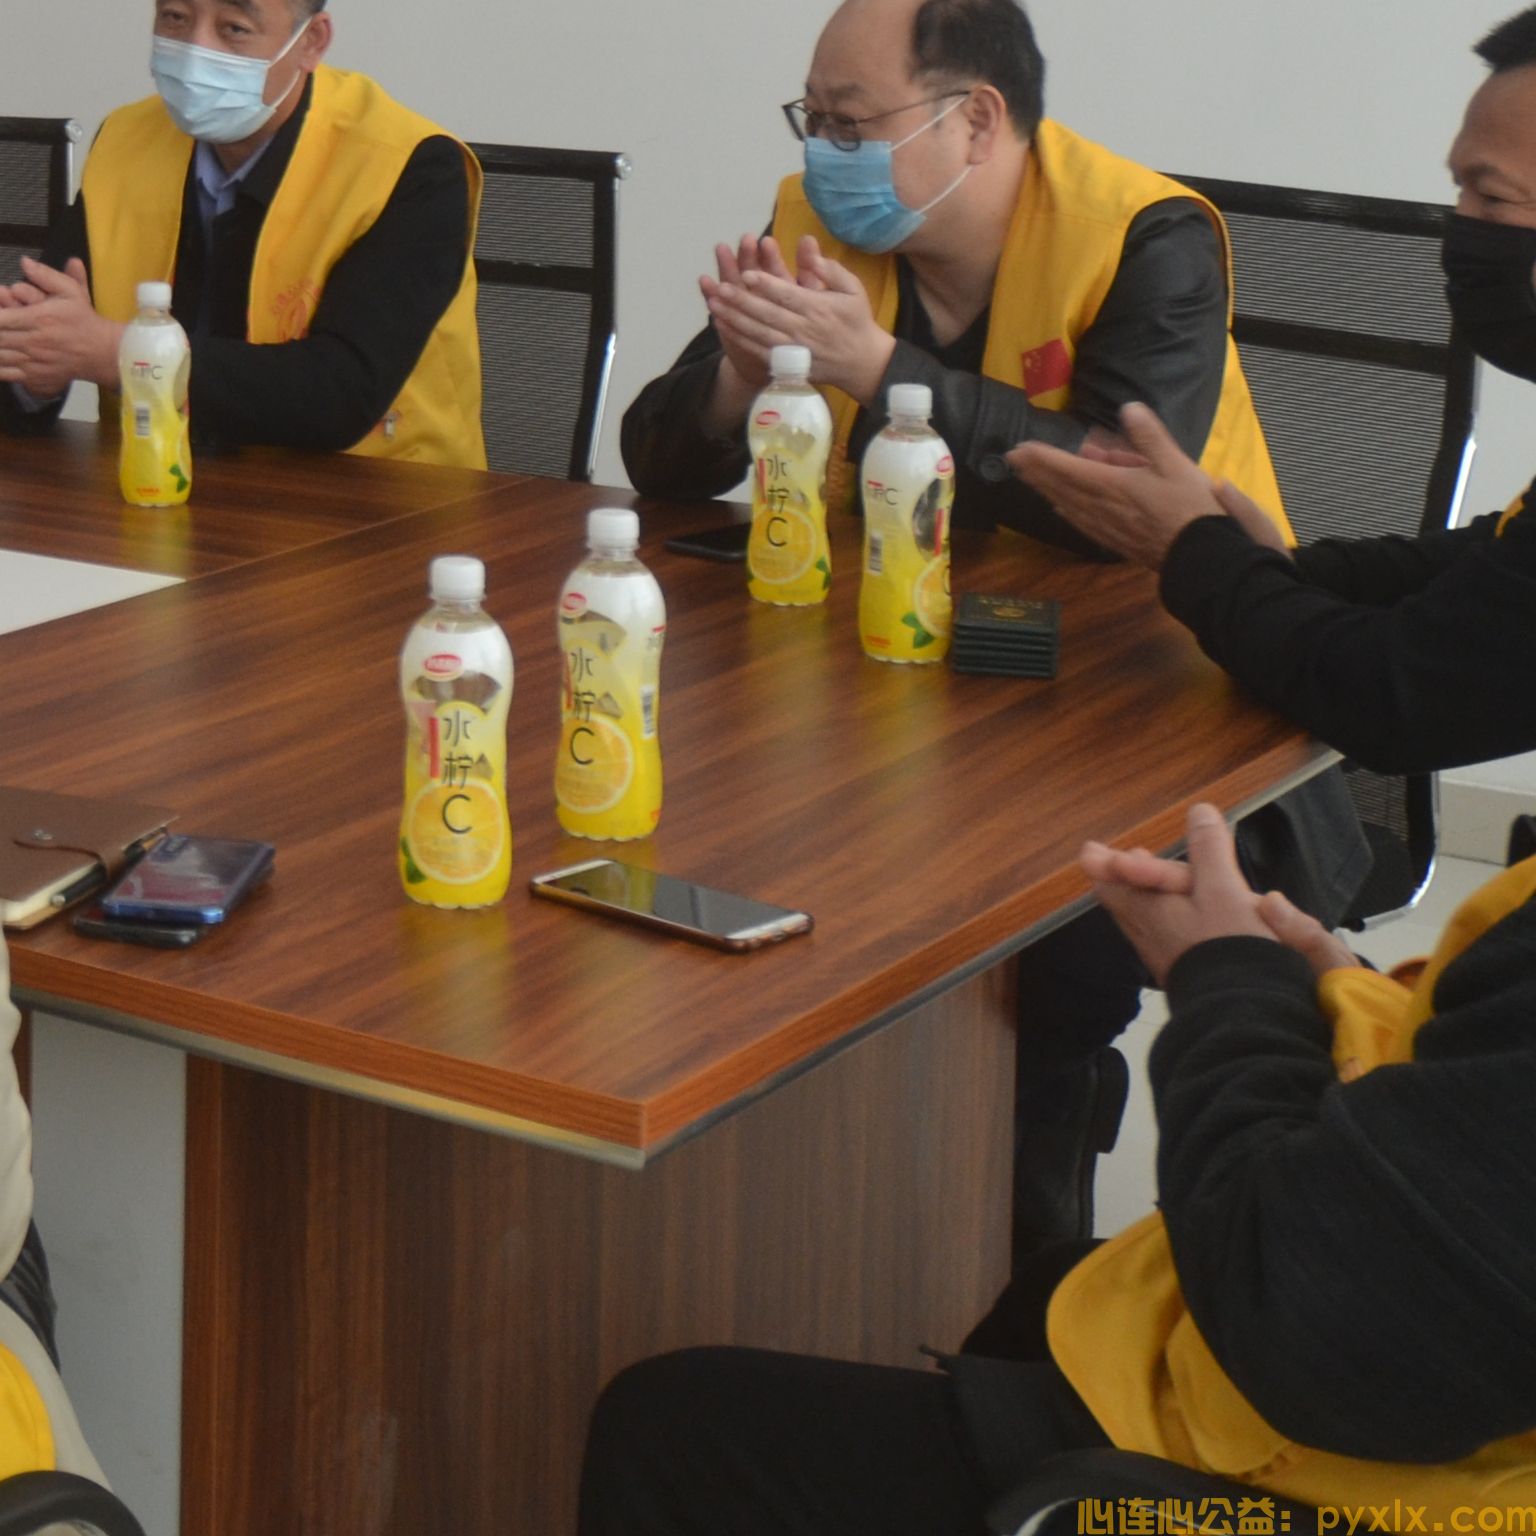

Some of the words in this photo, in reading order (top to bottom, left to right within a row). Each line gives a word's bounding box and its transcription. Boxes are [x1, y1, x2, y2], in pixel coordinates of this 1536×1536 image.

[765, 457, 791, 547] 水柠C
[569, 647, 596, 766] 水柠C
[442, 710, 475, 835] 水柠C
